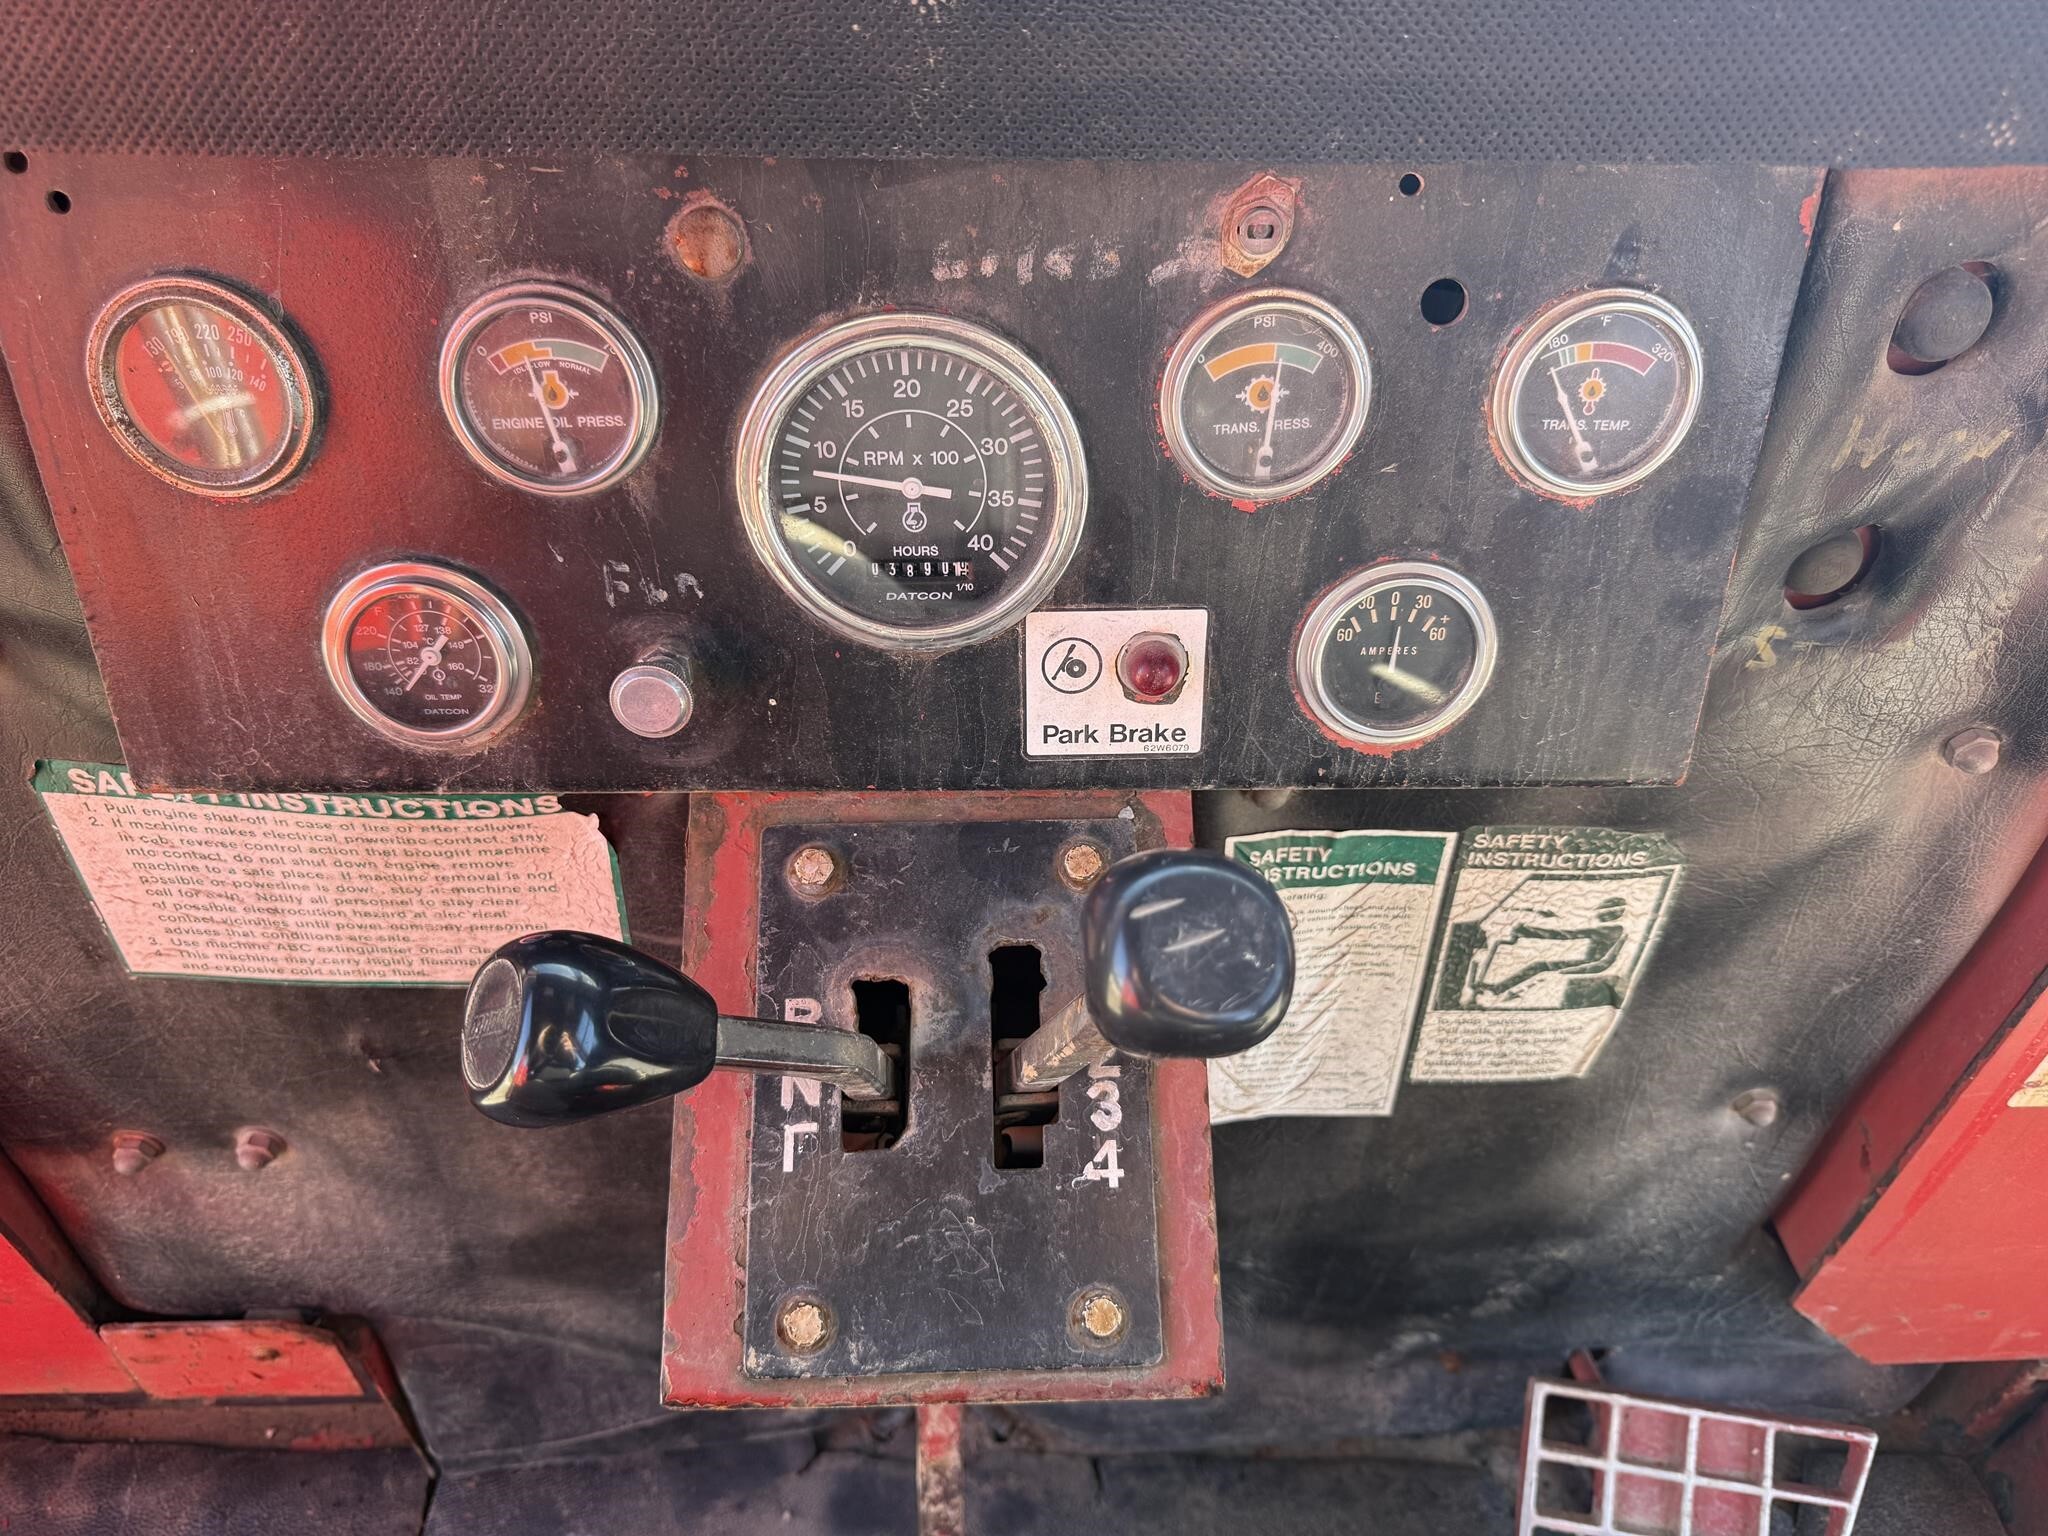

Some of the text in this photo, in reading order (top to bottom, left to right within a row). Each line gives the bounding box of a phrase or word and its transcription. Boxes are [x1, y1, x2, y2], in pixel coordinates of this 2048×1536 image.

[529, 312, 553, 323] PSI
[1253, 316, 1275, 328] PSI
[194, 324, 220, 340] 220
[227, 326, 252, 346] 250
[143, 336, 165, 358] 130
[1316, 340, 1339, 358] 400
[1548, 334, 1569, 350] 180
[1197, 354, 1205, 364] 0
[1651, 343, 1673, 363] 320
[205, 366, 223, 379] 100
[227, 368, 244, 382] 120
[559, 361, 591, 375] NORMAL
[250, 376, 267, 392] 140
[893, 379, 921, 398] 20
[842, 400, 865, 417] 15
[946, 400, 973, 417] 25
[492, 415, 627, 430] ENGINE OIL PRESS.
[1213, 417, 1312, 435] TRANS. RESS.
[1593, 419, 1631, 431] TEMP.
[814, 441, 837, 458] 10
[981, 438, 1009, 456] 30
[863, 451, 959, 466] RPM x 100
[814, 497, 827, 513] 5
[988, 490, 1014, 507] 35
[843, 540, 857, 557] 0
[967, 534, 994, 551] 40
[893, 546, 939, 557] HOURS
[956, 583, 974, 591] 1/10
[886, 592, 953, 600] DATCON
[1358, 596, 1375, 609] 30
[1391, 592, 1400, 606] 0
[1415, 595, 1432, 608] 30
[356, 626, 377, 636] 220
[413, 624, 429, 633] 127
[434, 625, 451, 635] 138
[1336, 629, 1353, 642] 60
[1429, 627, 1446, 641] 60
[402, 641, 419, 649] 104
[448, 641, 465, 650] 149
[1360, 646, 1418, 656] AMPERES
[363, 662, 383, 671] 180
[407, 657, 420, 665] 82
[448, 663, 465, 671] 160
[384, 687, 403, 696] 140
[1043, 723, 1186, 744] Park Brake
[1143, 744, 1190, 752] 62W6079
[238, 793, 563, 819] INSTRUCTIONS
[104, 803, 137, 815] Pull
[143, 808, 198, 820] engine
[274, 816, 289, 827] in
[296, 821, 332, 830] case
[339, 823, 356, 831] of
[89, 817, 103, 827] 2.
[129, 821, 198, 833] machine
[204, 826, 256, 838] makes
[263, 830, 338, 843] electrical
[180, 837, 238, 849] reverse
[244, 842, 302, 854] control
[309, 846, 360, 856] action
[478, 845, 551, 855] machine
[1473, 833, 1569, 850] SAFETY
[233, 853, 254, 863] do
[260, 856, 286, 865] not
[333, 858, 377, 869] down
[1249, 846, 1332, 867] SAFETY
[1467, 851, 1647, 868] INSTRUCTIONS
[133, 861, 200, 873] machine
[206, 865, 222, 874] to
[435, 872, 500, 882] removal
[507, 872, 520, 880] is
[1264, 861, 1417, 882] STRUCTIONS
[317, 884, 330, 892] is
[528, 884, 558, 894] and
[781, 1075, 822, 1110] N
[1086, 1080, 1122, 1132] 3
[1082, 1139, 1125, 1188] 4
